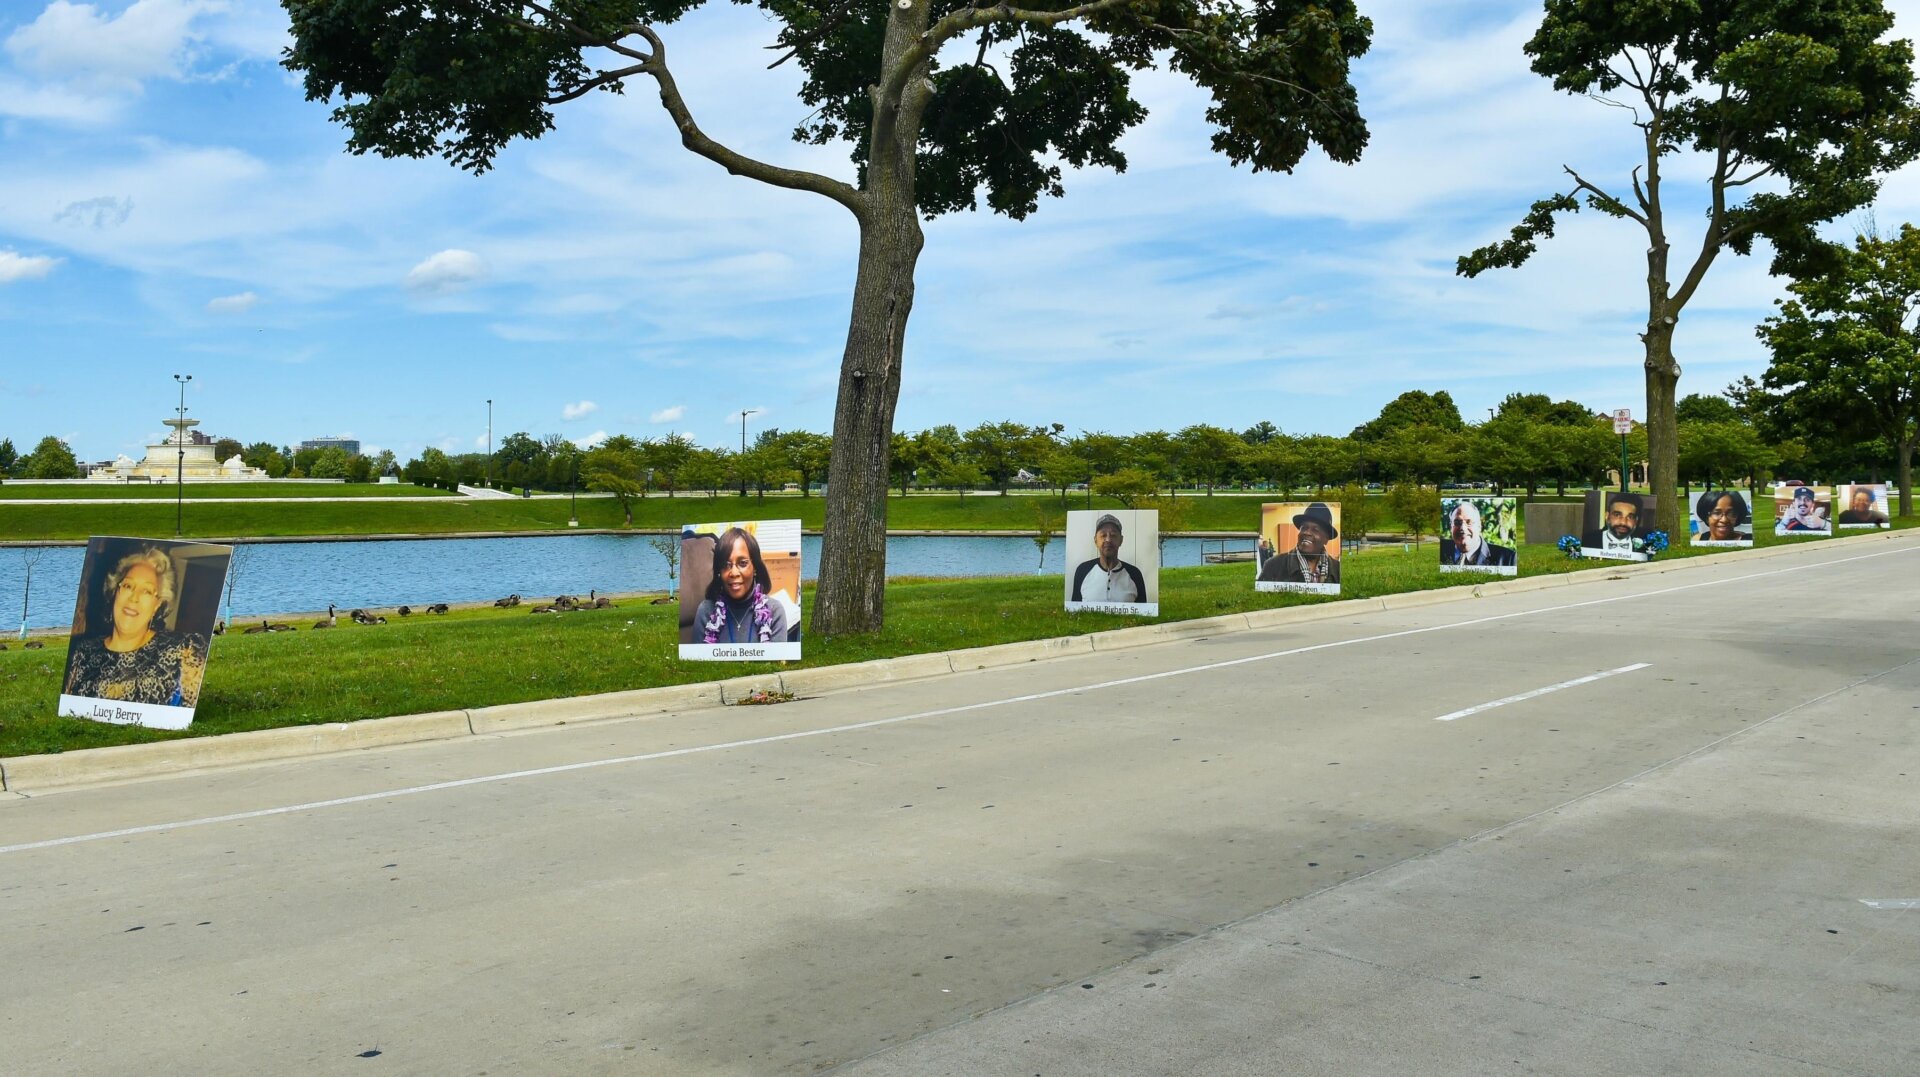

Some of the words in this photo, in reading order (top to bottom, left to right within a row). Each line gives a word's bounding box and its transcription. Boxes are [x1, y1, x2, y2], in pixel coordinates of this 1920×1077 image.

[1130, 606, 1139, 614] Sr.
[712, 648, 737, 657] Gloria
[739, 648, 765, 657] Bester
[93, 704, 114, 721] Lucy
[115, 707, 142, 725] Berry
